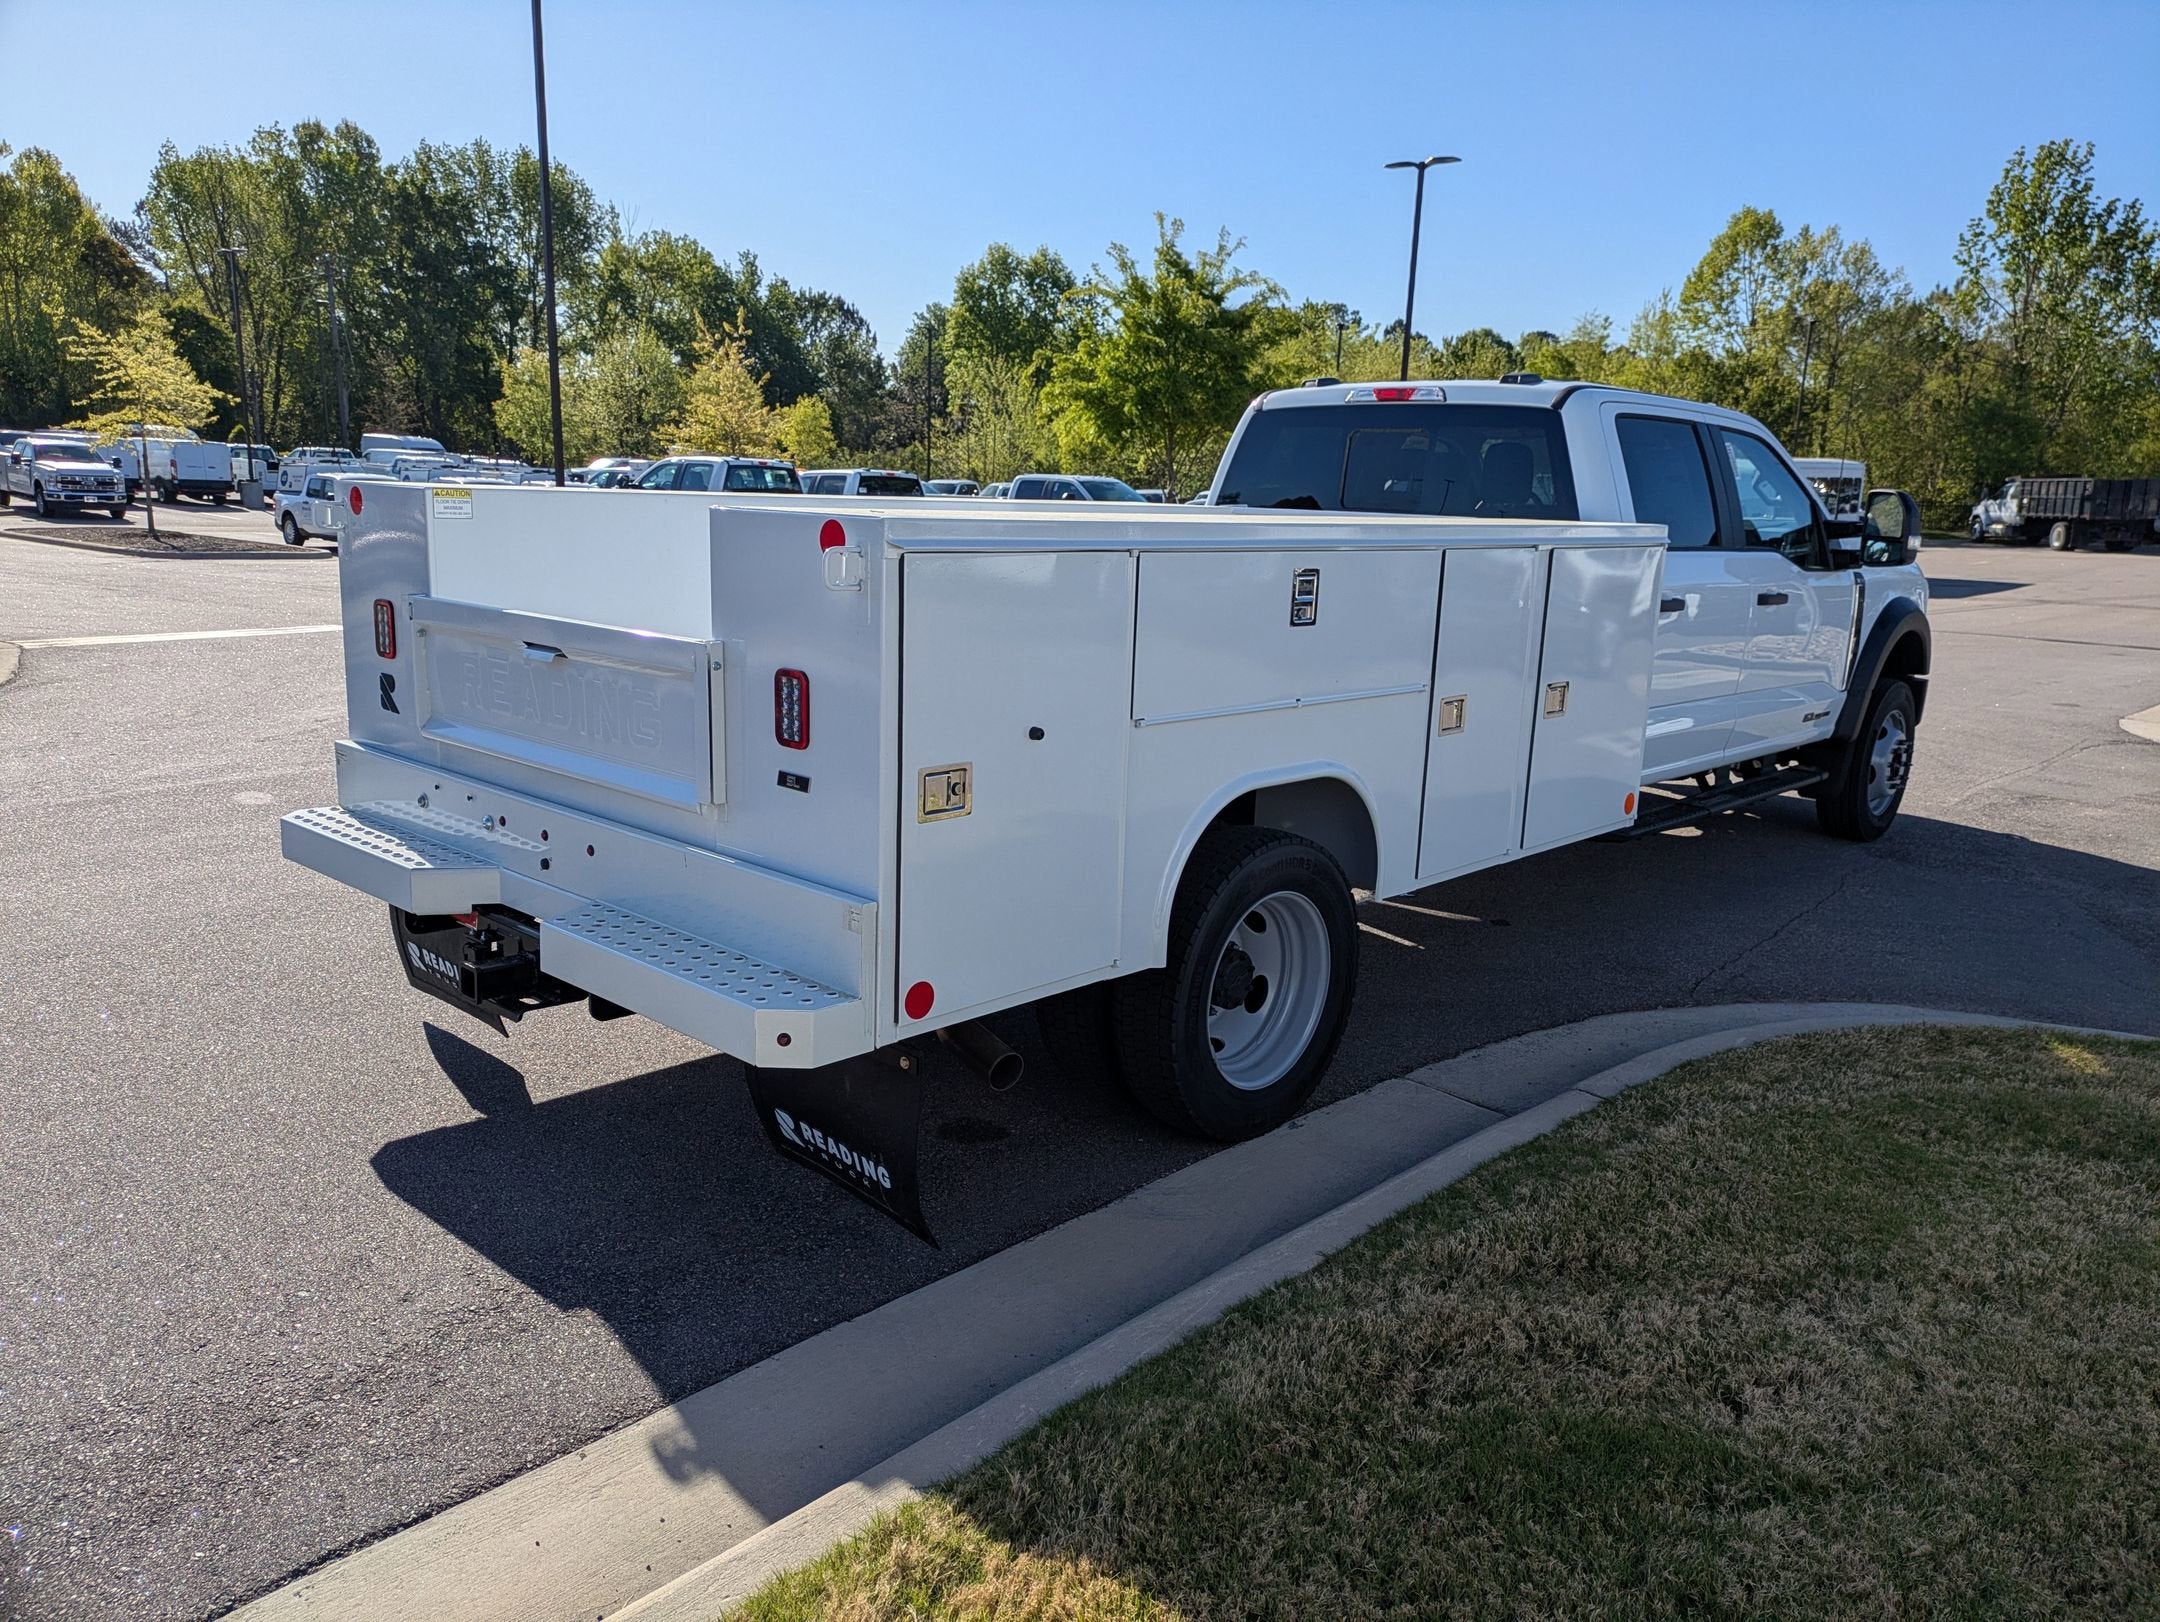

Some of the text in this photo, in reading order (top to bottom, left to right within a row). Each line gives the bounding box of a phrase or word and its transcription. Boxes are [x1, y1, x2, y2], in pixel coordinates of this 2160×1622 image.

[440, 489, 471, 497] CAUTION
[459, 650, 664, 749] READING
[421, 948, 460, 981] READI
[799, 1121, 892, 1189] READING
